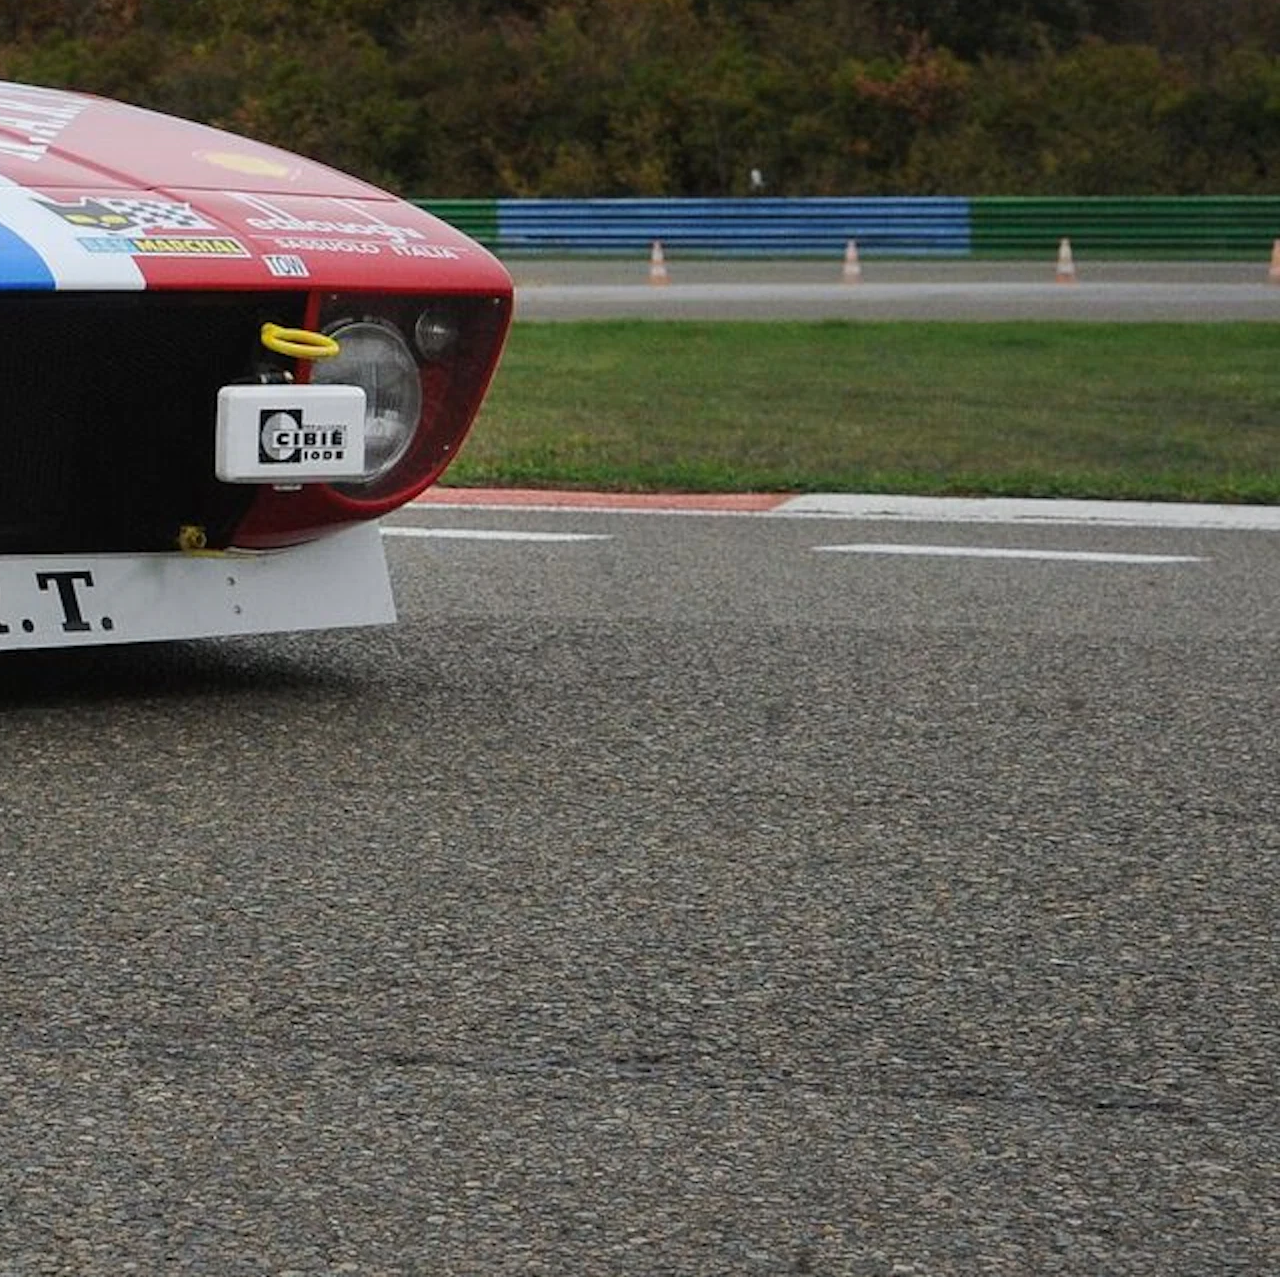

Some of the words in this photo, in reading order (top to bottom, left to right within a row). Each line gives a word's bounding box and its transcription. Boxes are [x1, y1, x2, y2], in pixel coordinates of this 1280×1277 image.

[134, 237, 242, 253] MARCHAL
[391, 243, 460, 260] ITALIA
[267, 255, 303, 275] TOW
